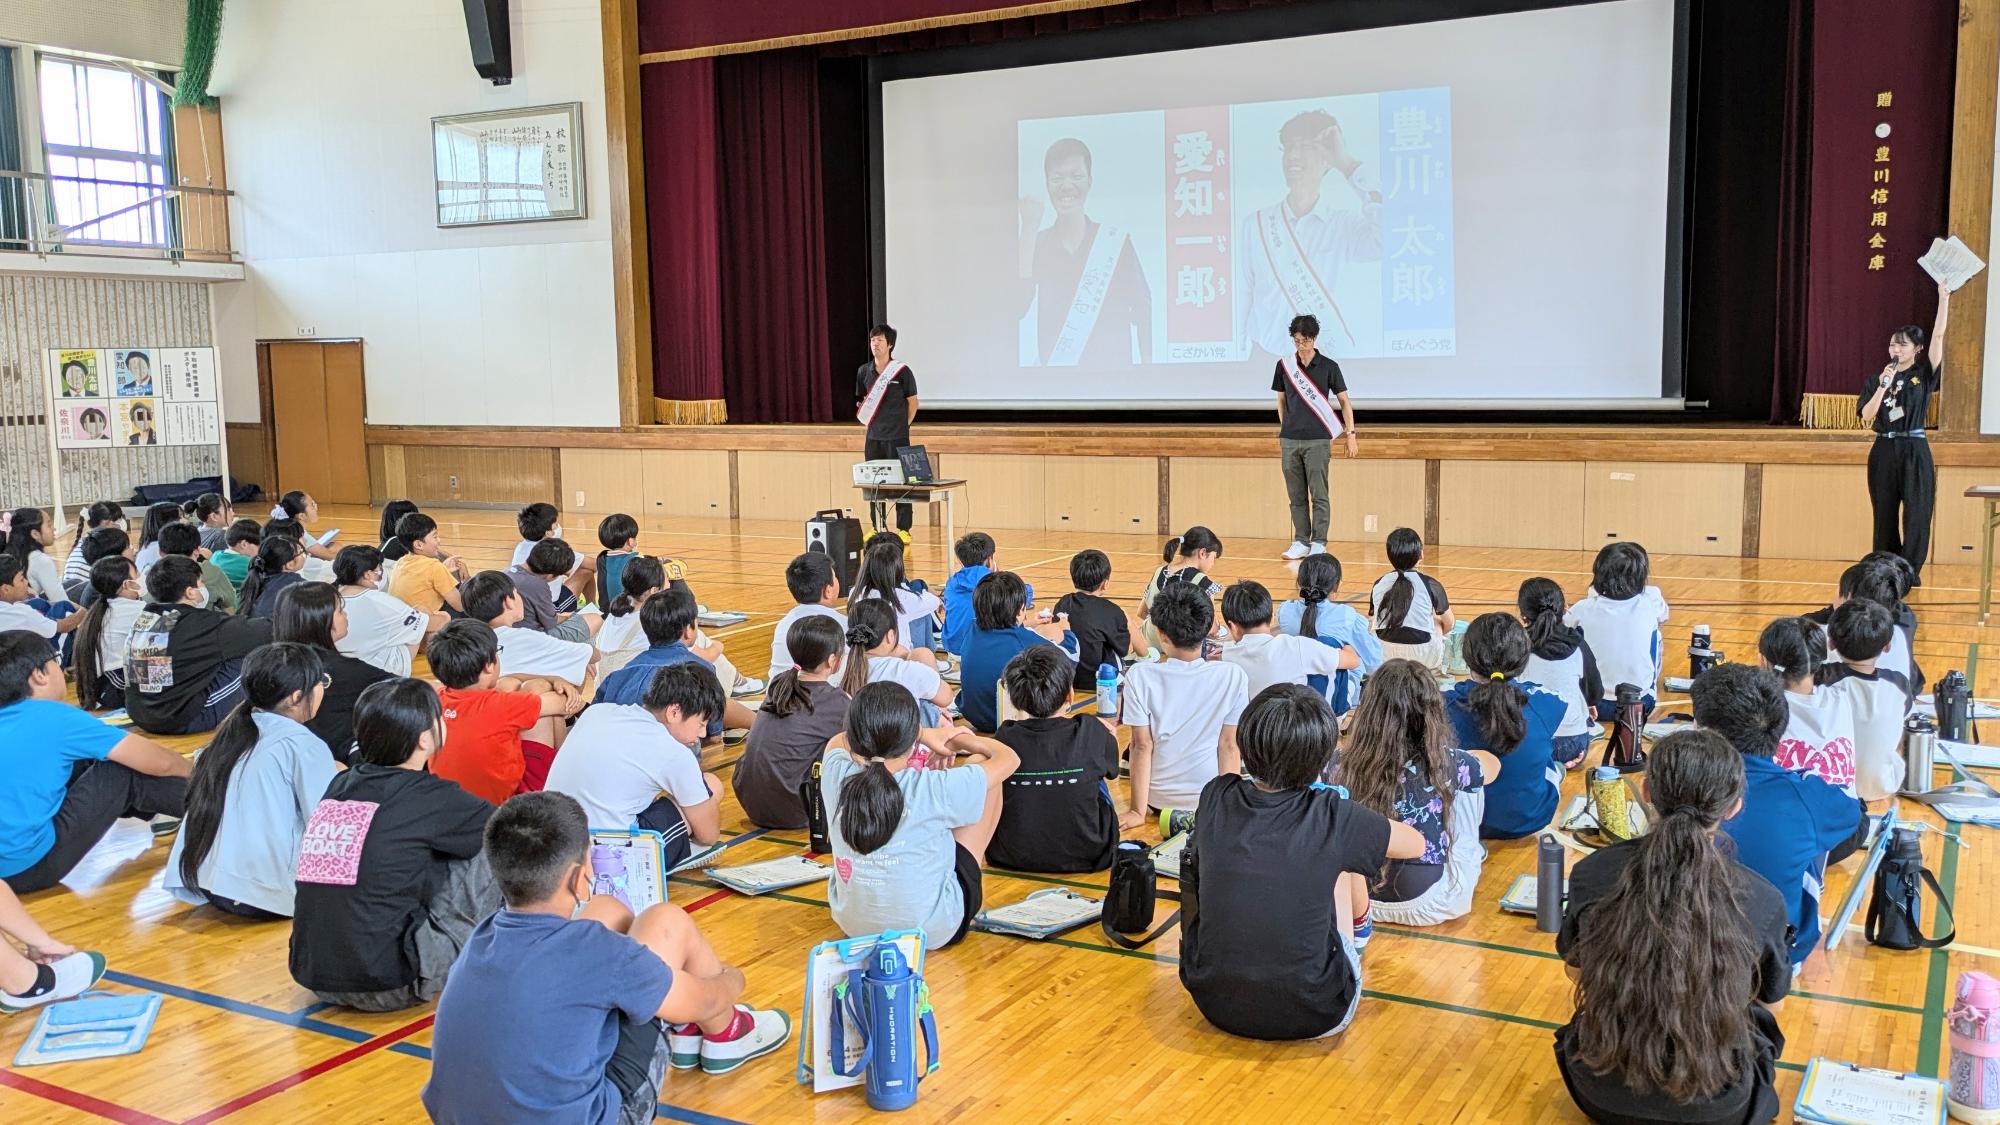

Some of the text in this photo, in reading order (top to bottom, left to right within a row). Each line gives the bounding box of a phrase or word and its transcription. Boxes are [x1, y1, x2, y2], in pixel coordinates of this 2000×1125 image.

[556, 128, 566, 153] 校歌
[1868, 91, 1892, 271] 贈 豊川信用金庫
[1388, 106, 1436, 306] 豊川太郎
[1173, 131, 1216, 308] 愛知一郎
[1172, 344, 1226, 359] こざかい党
[1391, 337, 1451, 352] ほんぐう党
[304, 823, 356, 843] LOVE
[302, 839, 350, 858] BOAT
[888, 1006, 896, 1063] HYDRATION
